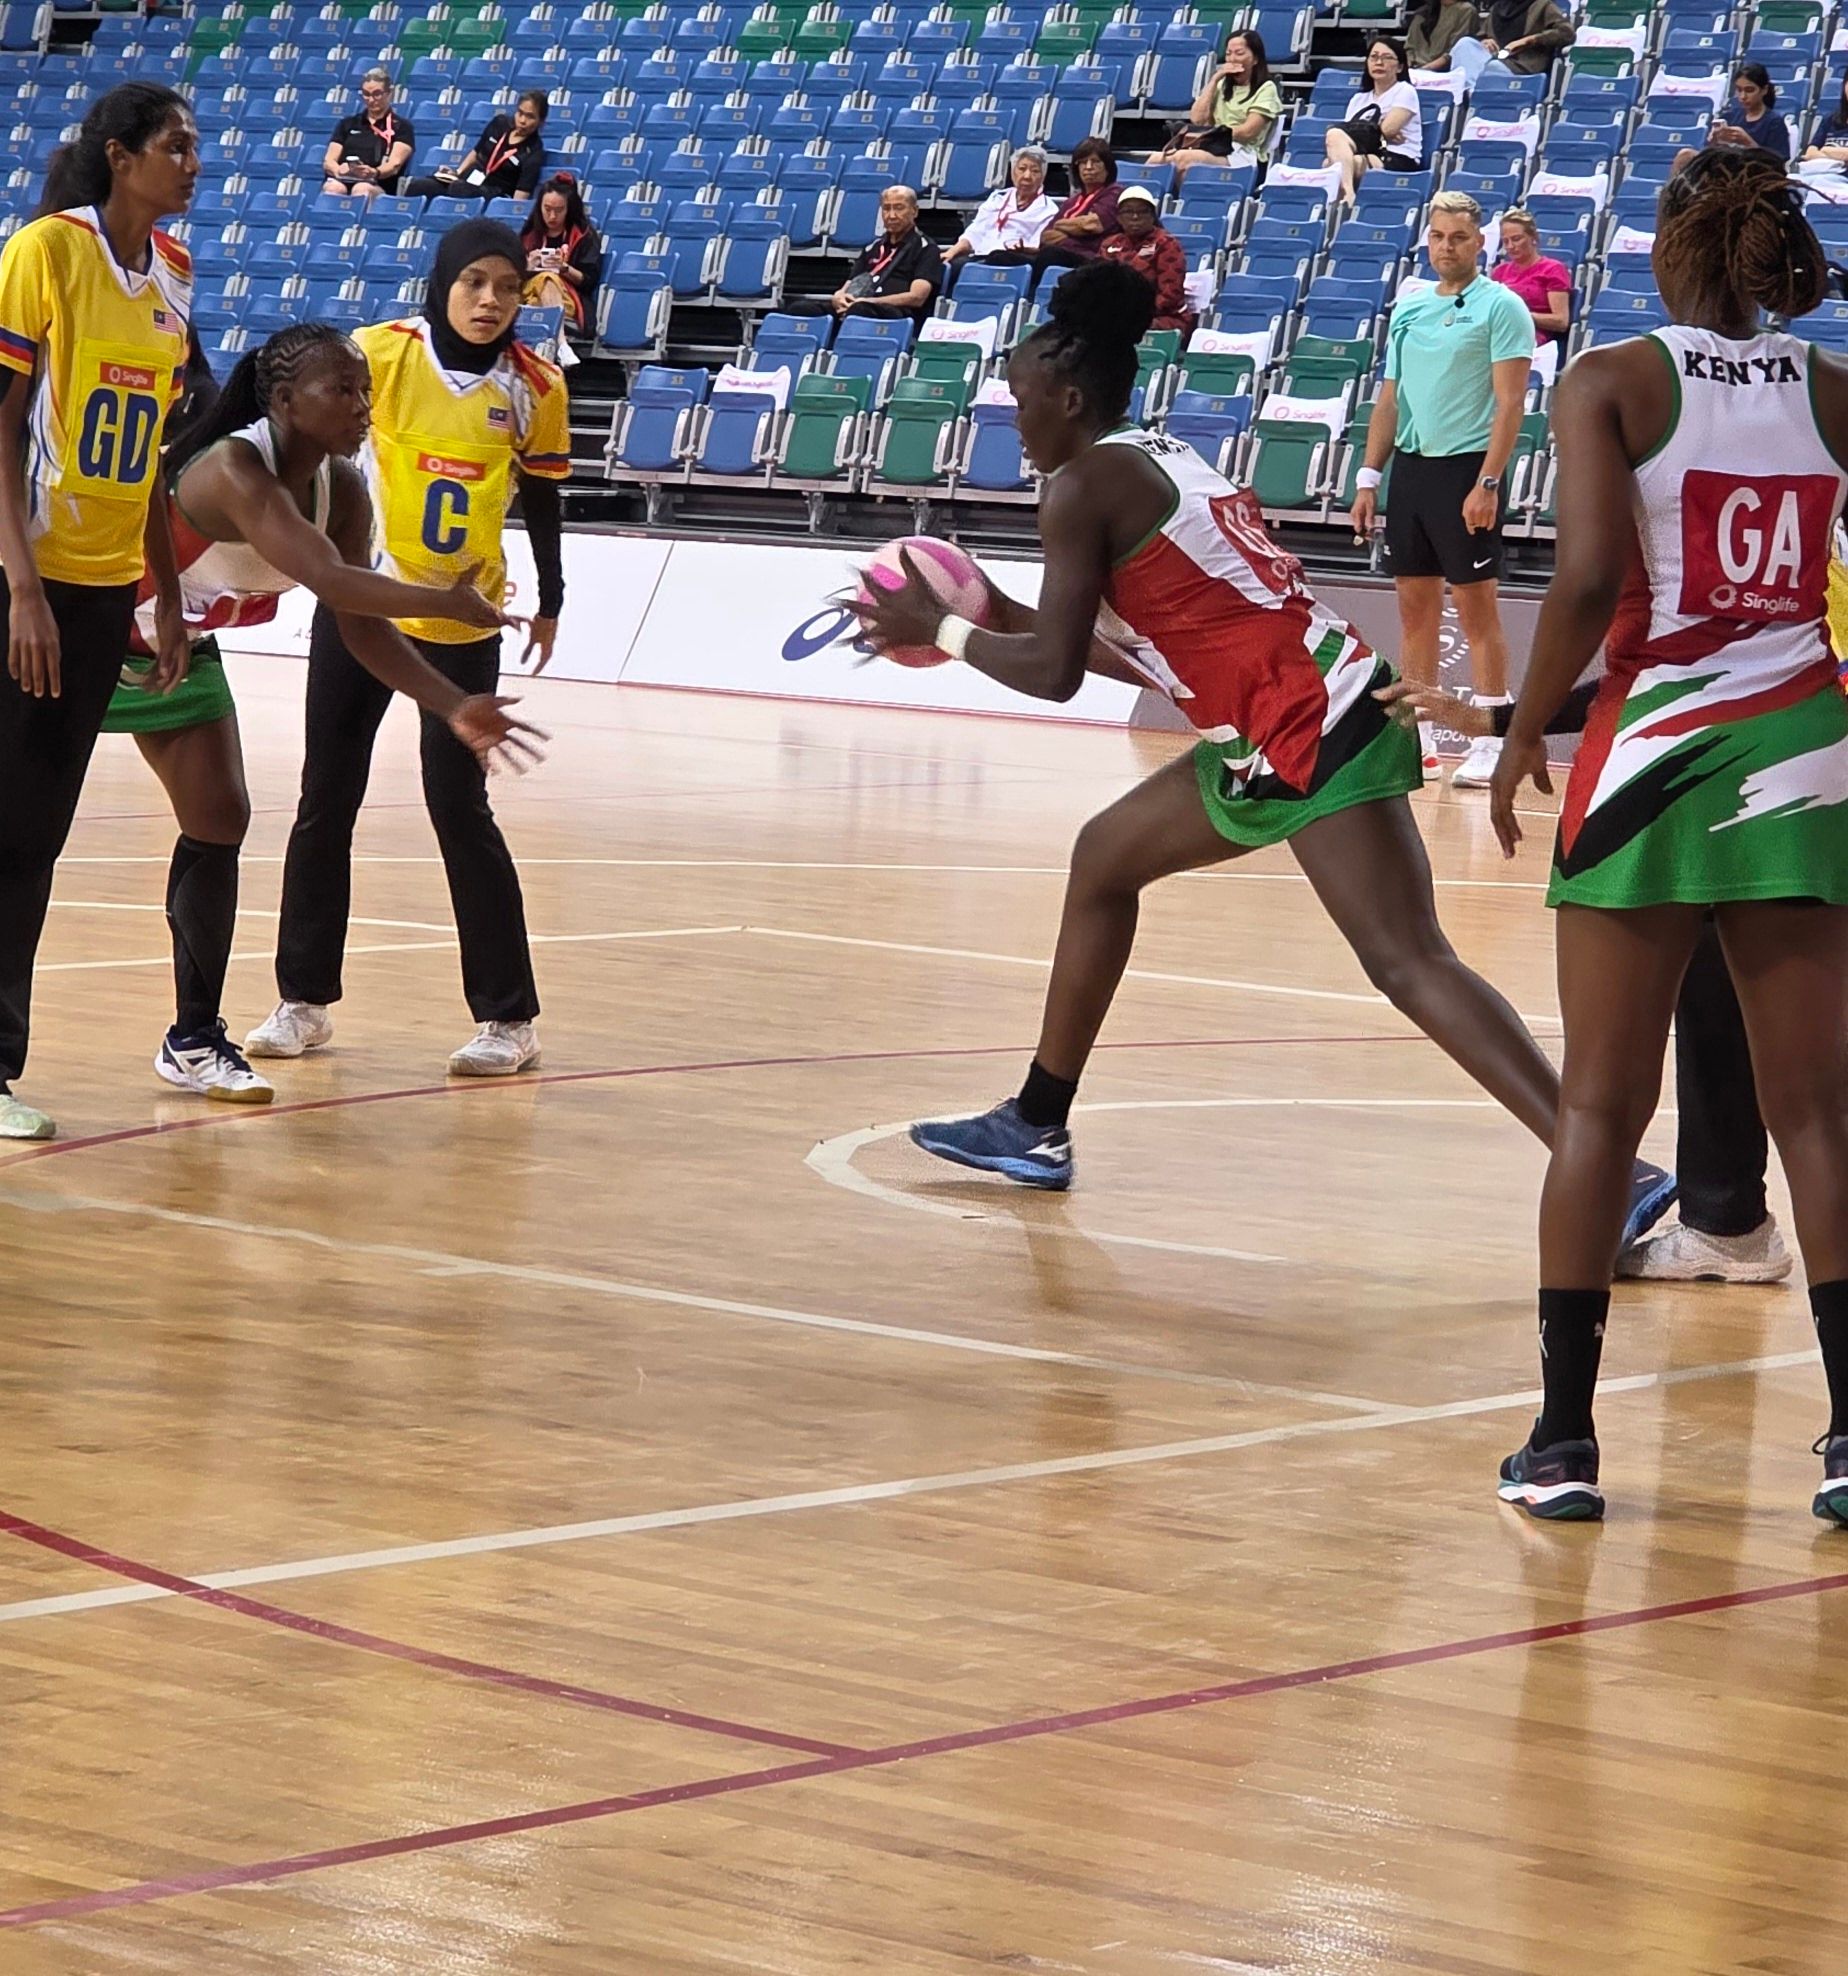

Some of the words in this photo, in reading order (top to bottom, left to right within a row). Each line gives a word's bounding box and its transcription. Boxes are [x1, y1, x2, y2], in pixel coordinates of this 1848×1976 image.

[1684, 350, 1802, 387] KENYA
[79, 388, 159, 483] GD
[421, 478, 469, 555] C
[1717, 486, 1801, 589] GA
[1741, 592, 1801, 614] Singlife
